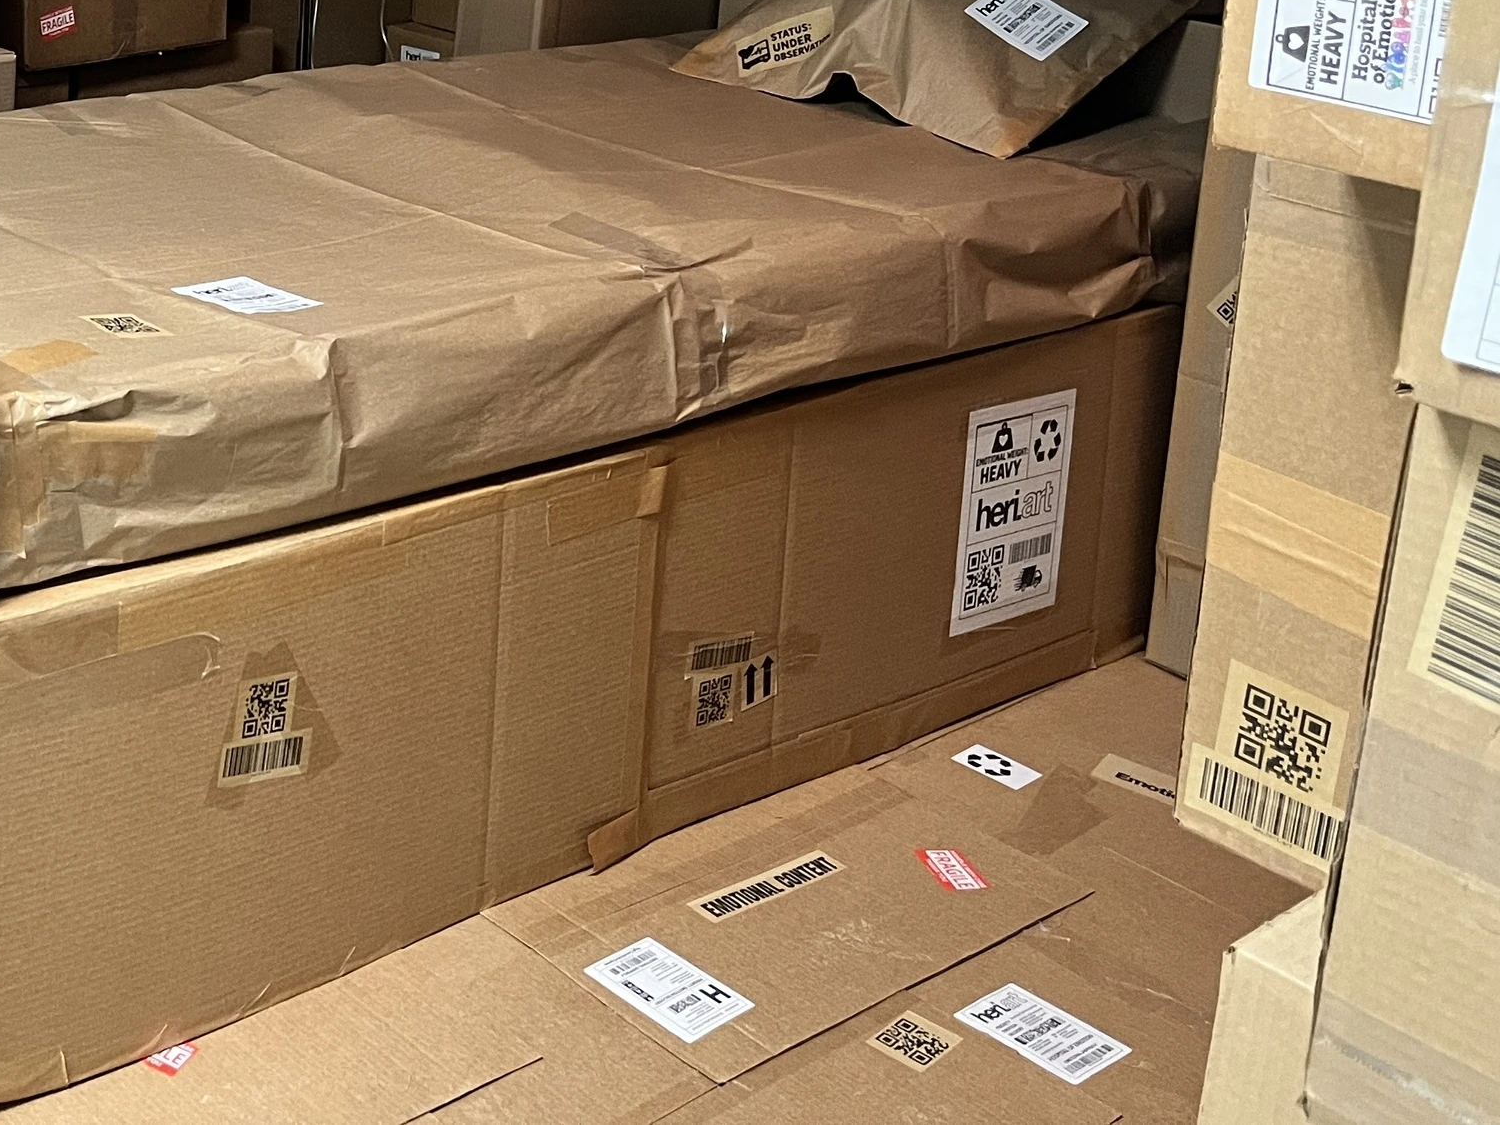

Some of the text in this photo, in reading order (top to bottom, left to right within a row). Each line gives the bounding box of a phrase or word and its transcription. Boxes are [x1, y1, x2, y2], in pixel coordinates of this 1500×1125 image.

[42, 12, 75, 35] FRAGILE
[770, 22, 813, 43] STATUS:
[772, 33, 812, 53] UNDER
[1318, 10, 1348, 87] HEAVY
[1351, 0, 1379, 83] Hospital
[1304, 38, 1318, 92] EMOTIONAL
[1372, 62, 1387, 85] of
[976, 446, 1029, 467] EMOTIONAL WEIGHT:
[979, 458, 1022, 485] HEAVY
[975, 480, 1054, 533] heri.art
[934, 851, 975, 889] FRAGILE
[700, 855, 838, 919] EMOTIONAL CONTENT
[699, 983, 732, 1004] H
